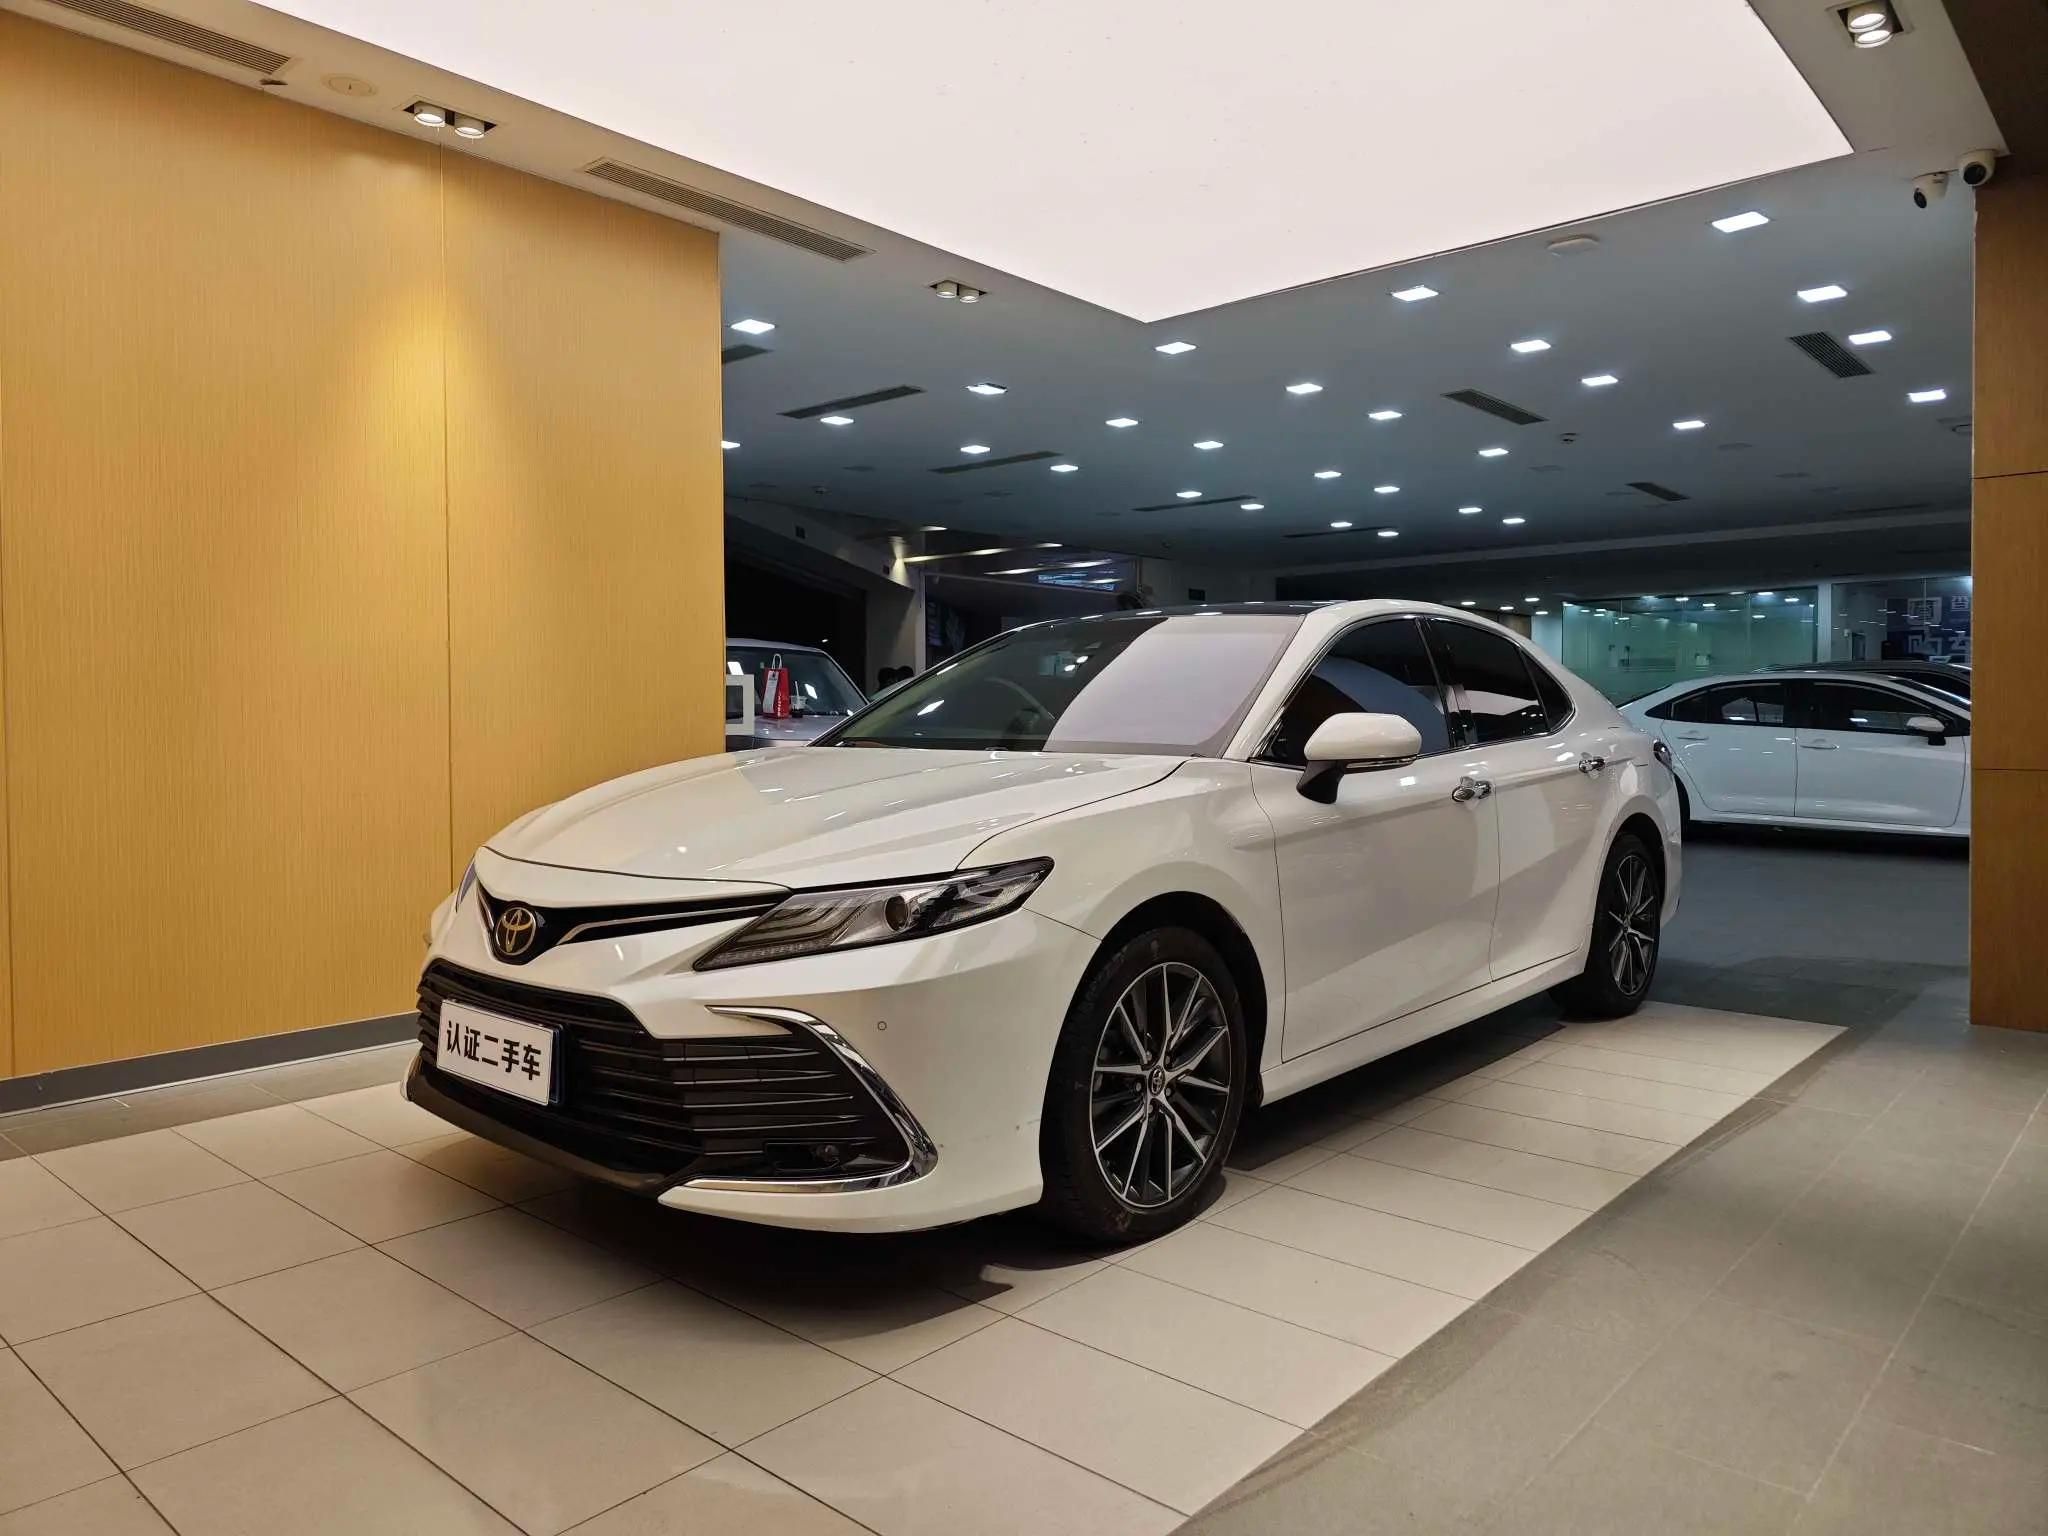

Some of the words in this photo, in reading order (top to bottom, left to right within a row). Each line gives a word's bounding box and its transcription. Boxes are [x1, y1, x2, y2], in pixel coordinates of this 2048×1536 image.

[446, 1020, 542, 1081] 认证二手车
